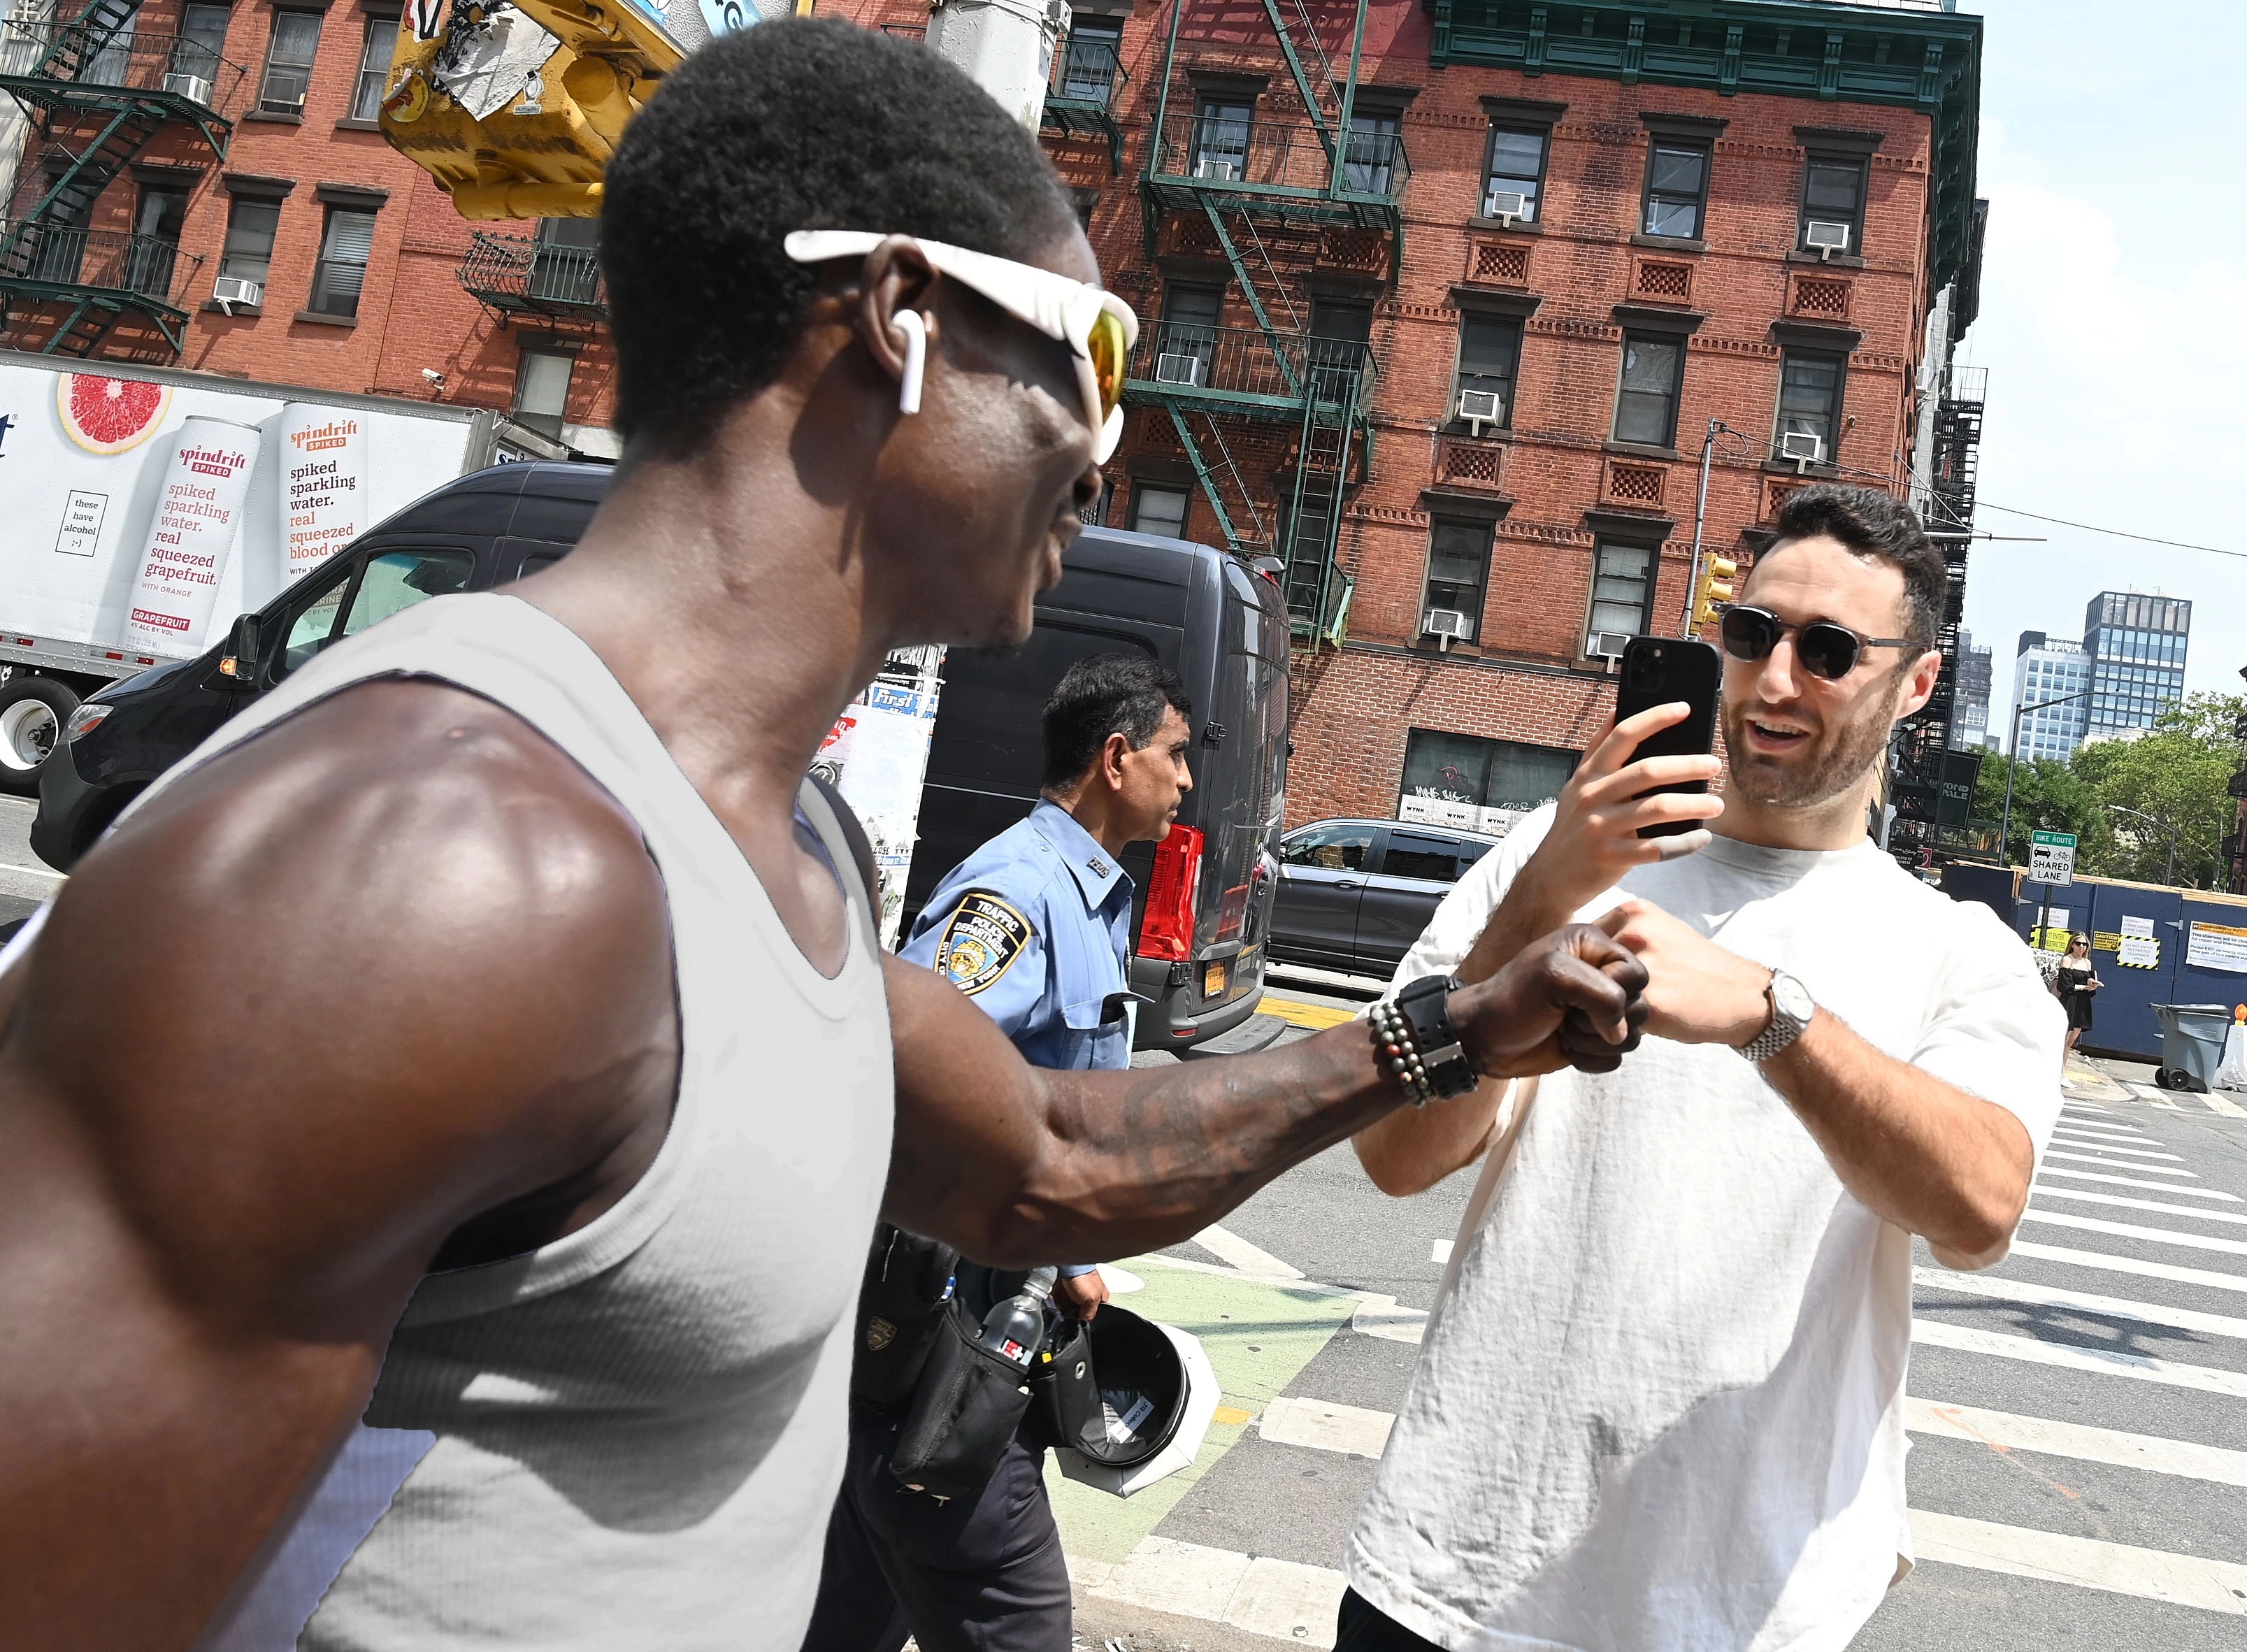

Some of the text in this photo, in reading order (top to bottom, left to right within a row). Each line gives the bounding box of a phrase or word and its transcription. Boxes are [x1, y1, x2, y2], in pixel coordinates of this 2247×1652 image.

[290, 419, 358, 448] spindrift
[309, 439, 344, 450] SPIKED
[179, 445, 246, 469] spindrift
[194, 464, 229, 477] SPIKED
[290, 460, 337, 482] spiked
[168, 483, 216, 501] spiked
[290, 475, 356, 497] sparkling
[75, 499, 99, 510] these
[290, 496, 334, 510] water.
[73, 512, 94, 522] have
[164, 500, 231, 524] sparkling
[289, 511, 316, 527] real
[64, 524, 96, 536] alcohol
[161, 515, 203, 532] water.
[155, 531, 182, 545] real
[290, 522, 354, 545] squeezed
[150, 547, 215, 568] squeezed
[289, 543, 329, 559] blood
[145, 563, 217, 586] grapefruit.
[142, 582, 192, 598] WITH ORANGE
[133, 610, 188, 629] GRAPEFRUIT
[139, 623, 150, 631] ALC
[873, 687, 914, 708] First
[2052, 836, 2072, 845] ROUTE
[2033, 860, 2069, 871] SHARED
[2038, 870, 2062, 881] LANE
[976, 900, 1019, 933] TRAFFIC
[970, 916, 1007, 942] POLICE
[954, 922, 1009, 958] DEPARTMENT
[2046, 940, 2066, 949] ESTRICTED
[939, 941, 950, 963] CITY
[976, 964, 1000, 984] YORK
